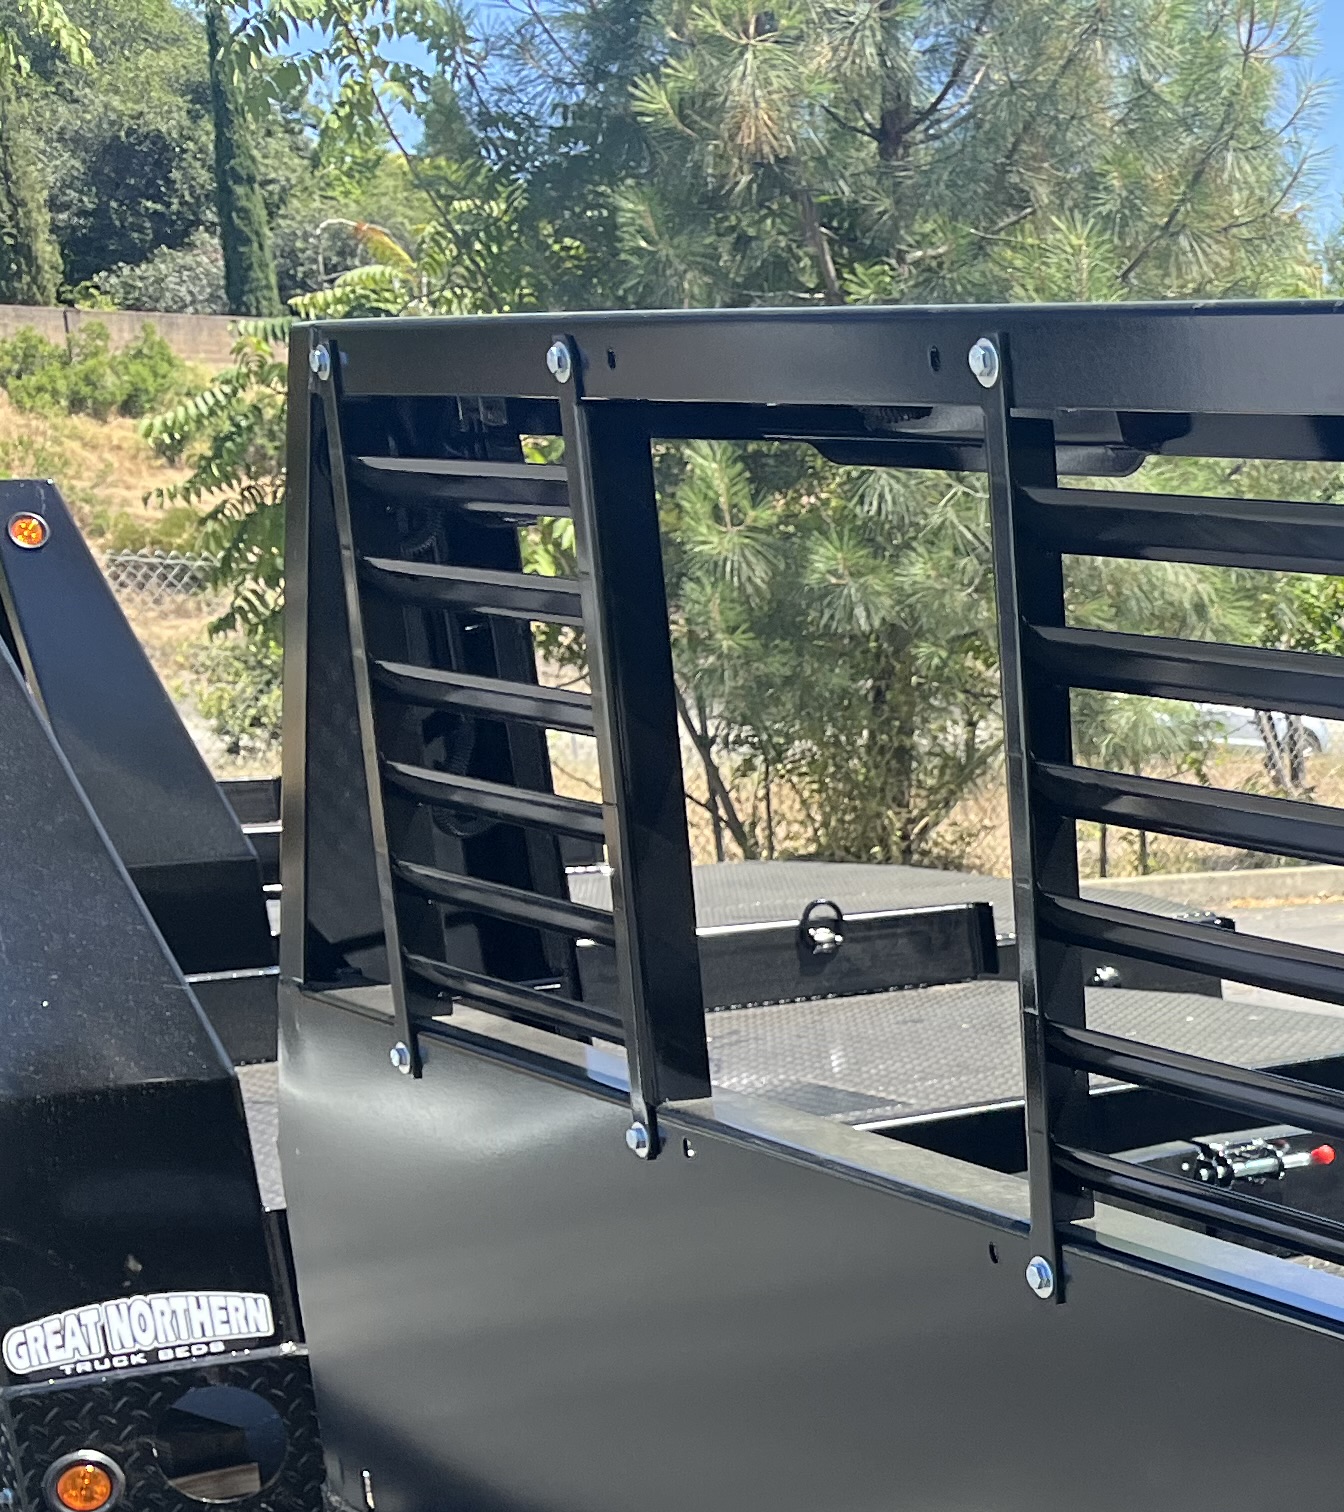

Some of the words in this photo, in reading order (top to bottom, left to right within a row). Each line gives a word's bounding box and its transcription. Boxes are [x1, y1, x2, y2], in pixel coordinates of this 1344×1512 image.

[6, 1305, 104, 1372] GREAT
[104, 1294, 272, 1353] NORTHERN
[60, 1354, 148, 1376] TRUCK
[157, 1341, 226, 1362] BEDS
